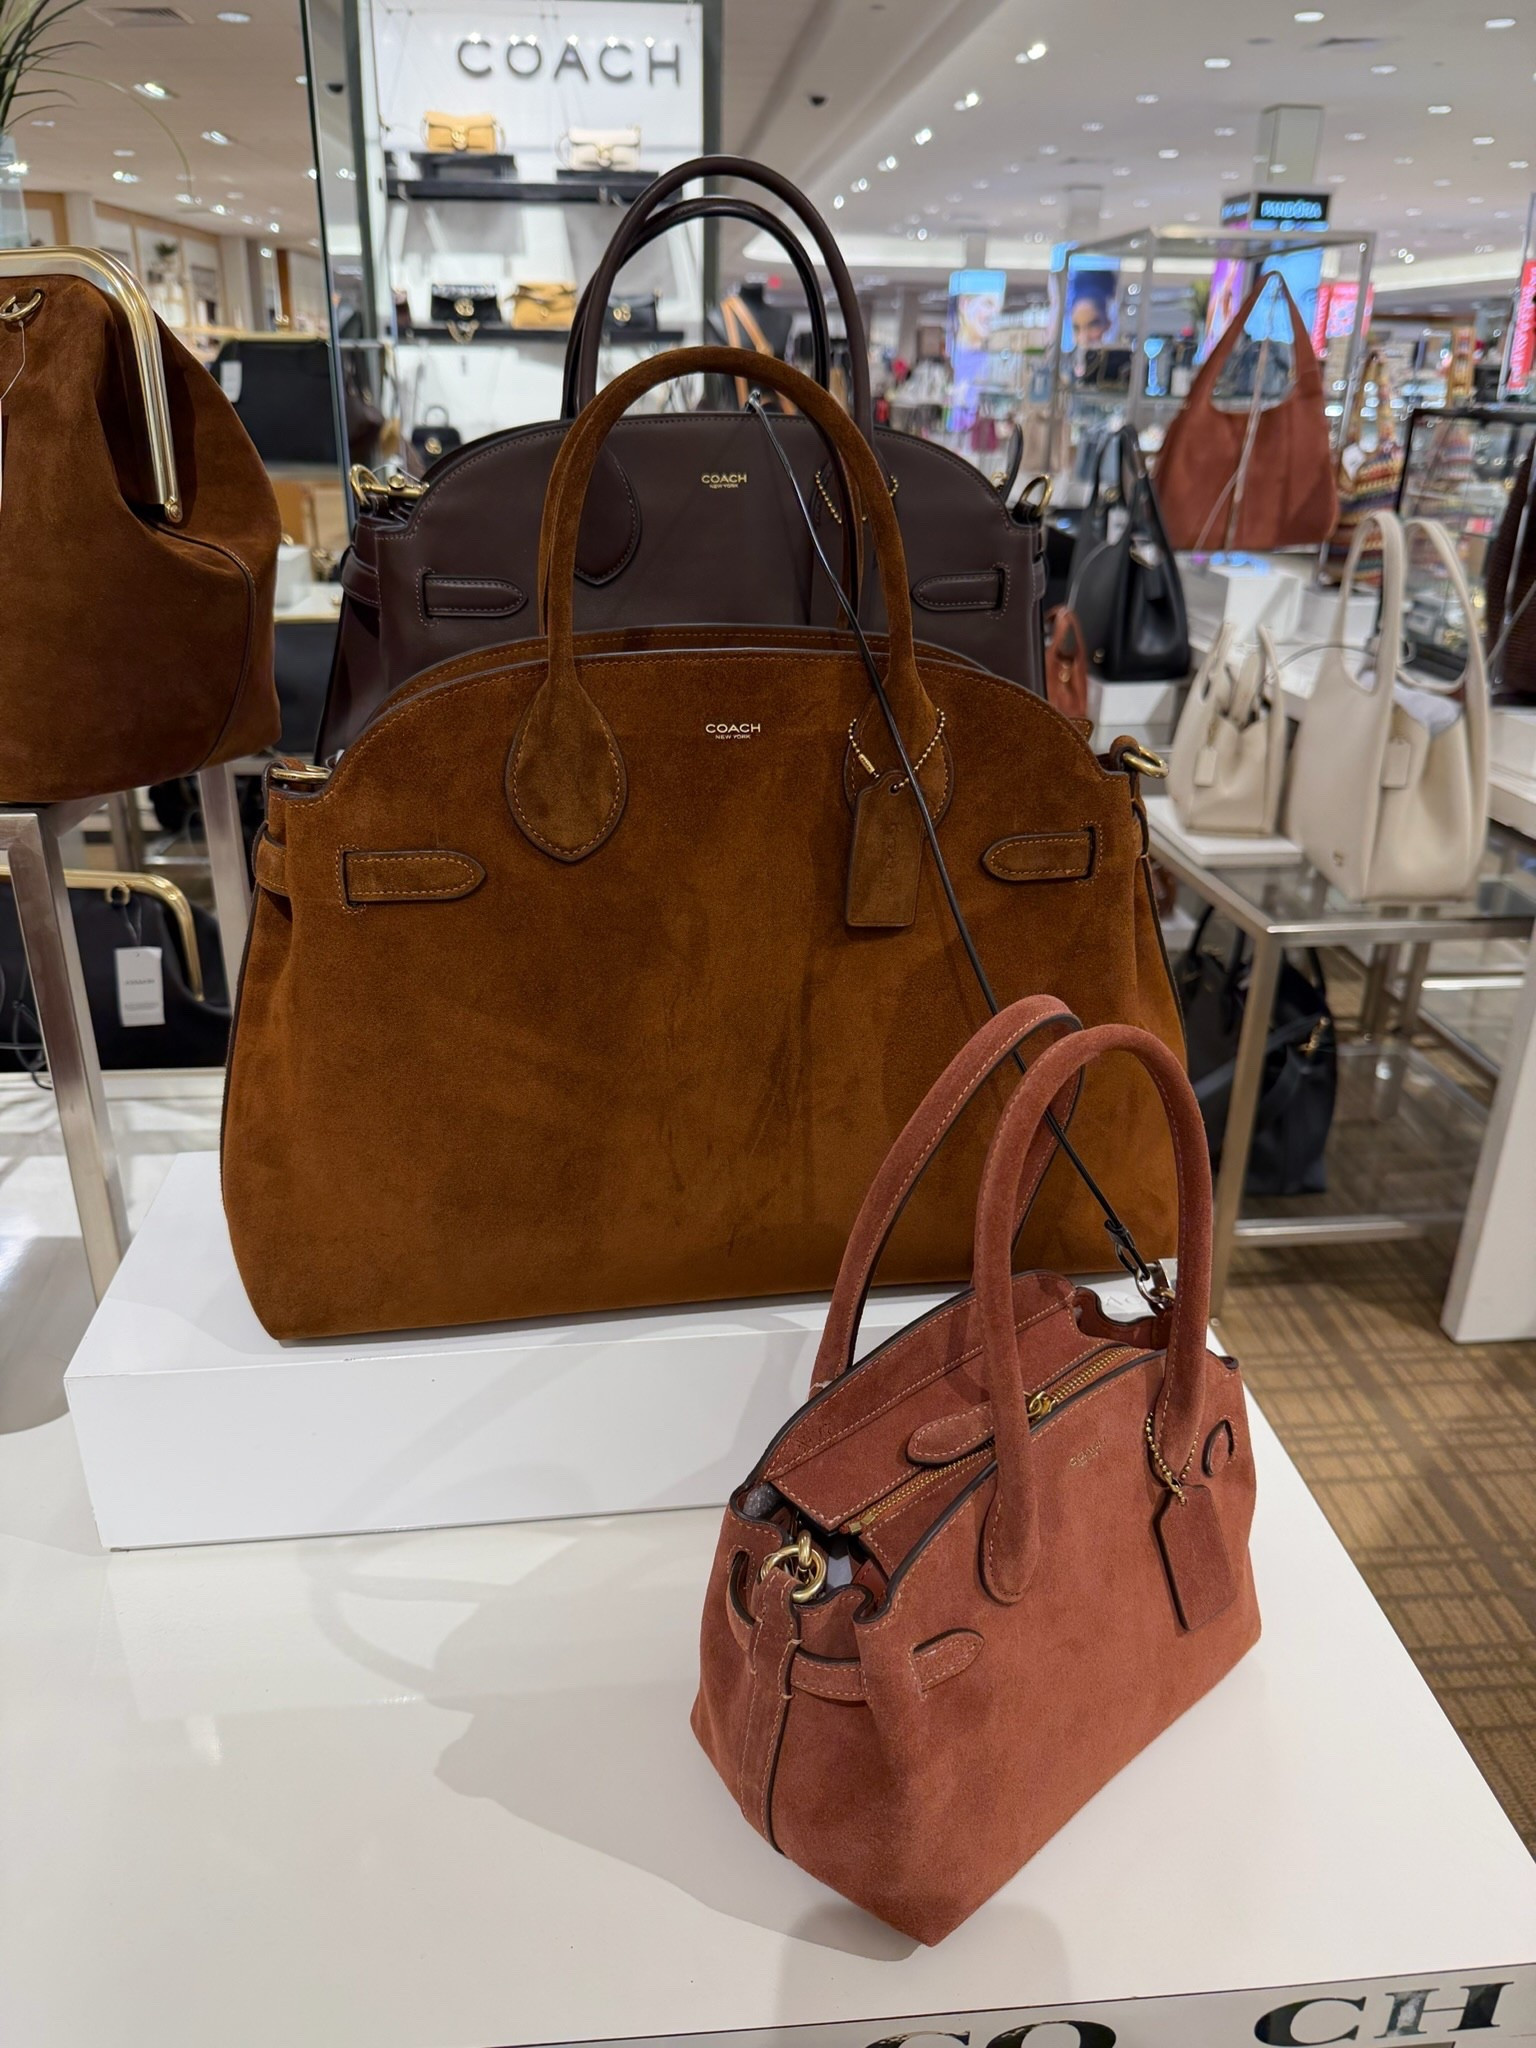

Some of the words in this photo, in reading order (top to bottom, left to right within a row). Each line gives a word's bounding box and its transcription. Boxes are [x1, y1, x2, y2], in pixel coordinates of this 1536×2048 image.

[457, 37, 681, 86] COACH
[1260, 199, 1322, 219] PANDORA
[701, 473, 748, 484] COACH
[705, 723, 761, 733] COACH
